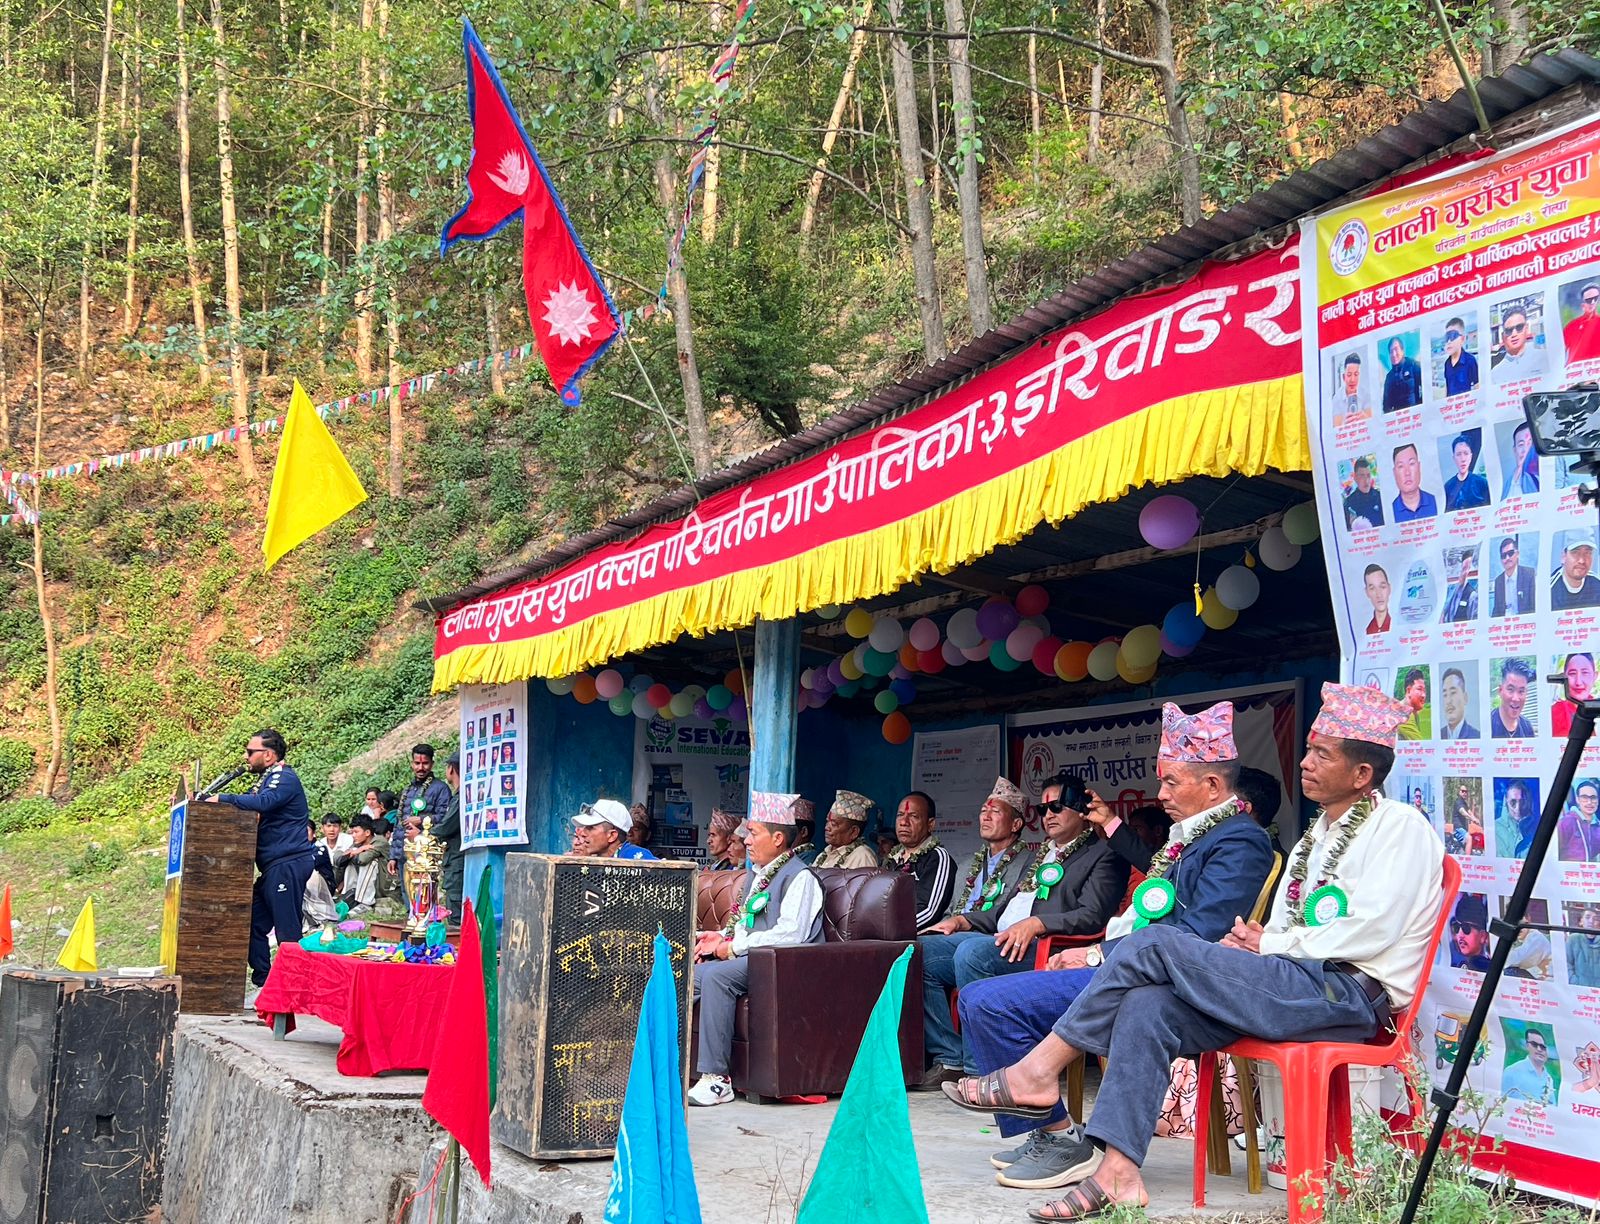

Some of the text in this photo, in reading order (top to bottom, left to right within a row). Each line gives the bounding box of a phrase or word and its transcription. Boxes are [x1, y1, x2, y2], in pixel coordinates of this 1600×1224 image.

[1373, 207, 1439, 254] लाली
[1530, 152, 1591, 198] युवा
[1542, 199, 1569, 219] रोल्पा
[1321, 299, 1345, 323] लाली
[1375, 283, 1396, 306] युवा
[1377, 294, 1421, 324] सहयोगी
[1486, 256, 1545, 287] नामावली
[443, 598, 489, 638] लाली
[547, 563, 598, 624] युवा
[663, 487, 775, 572] परिवर्तन
[645, 745, 672, 754] SEWA
[678, 727, 750, 746] SEWA
[678, 743, 720, 754] International
[1102, 752, 1147, 787] गुराँस
[672, 848, 694, 856] STUDY
